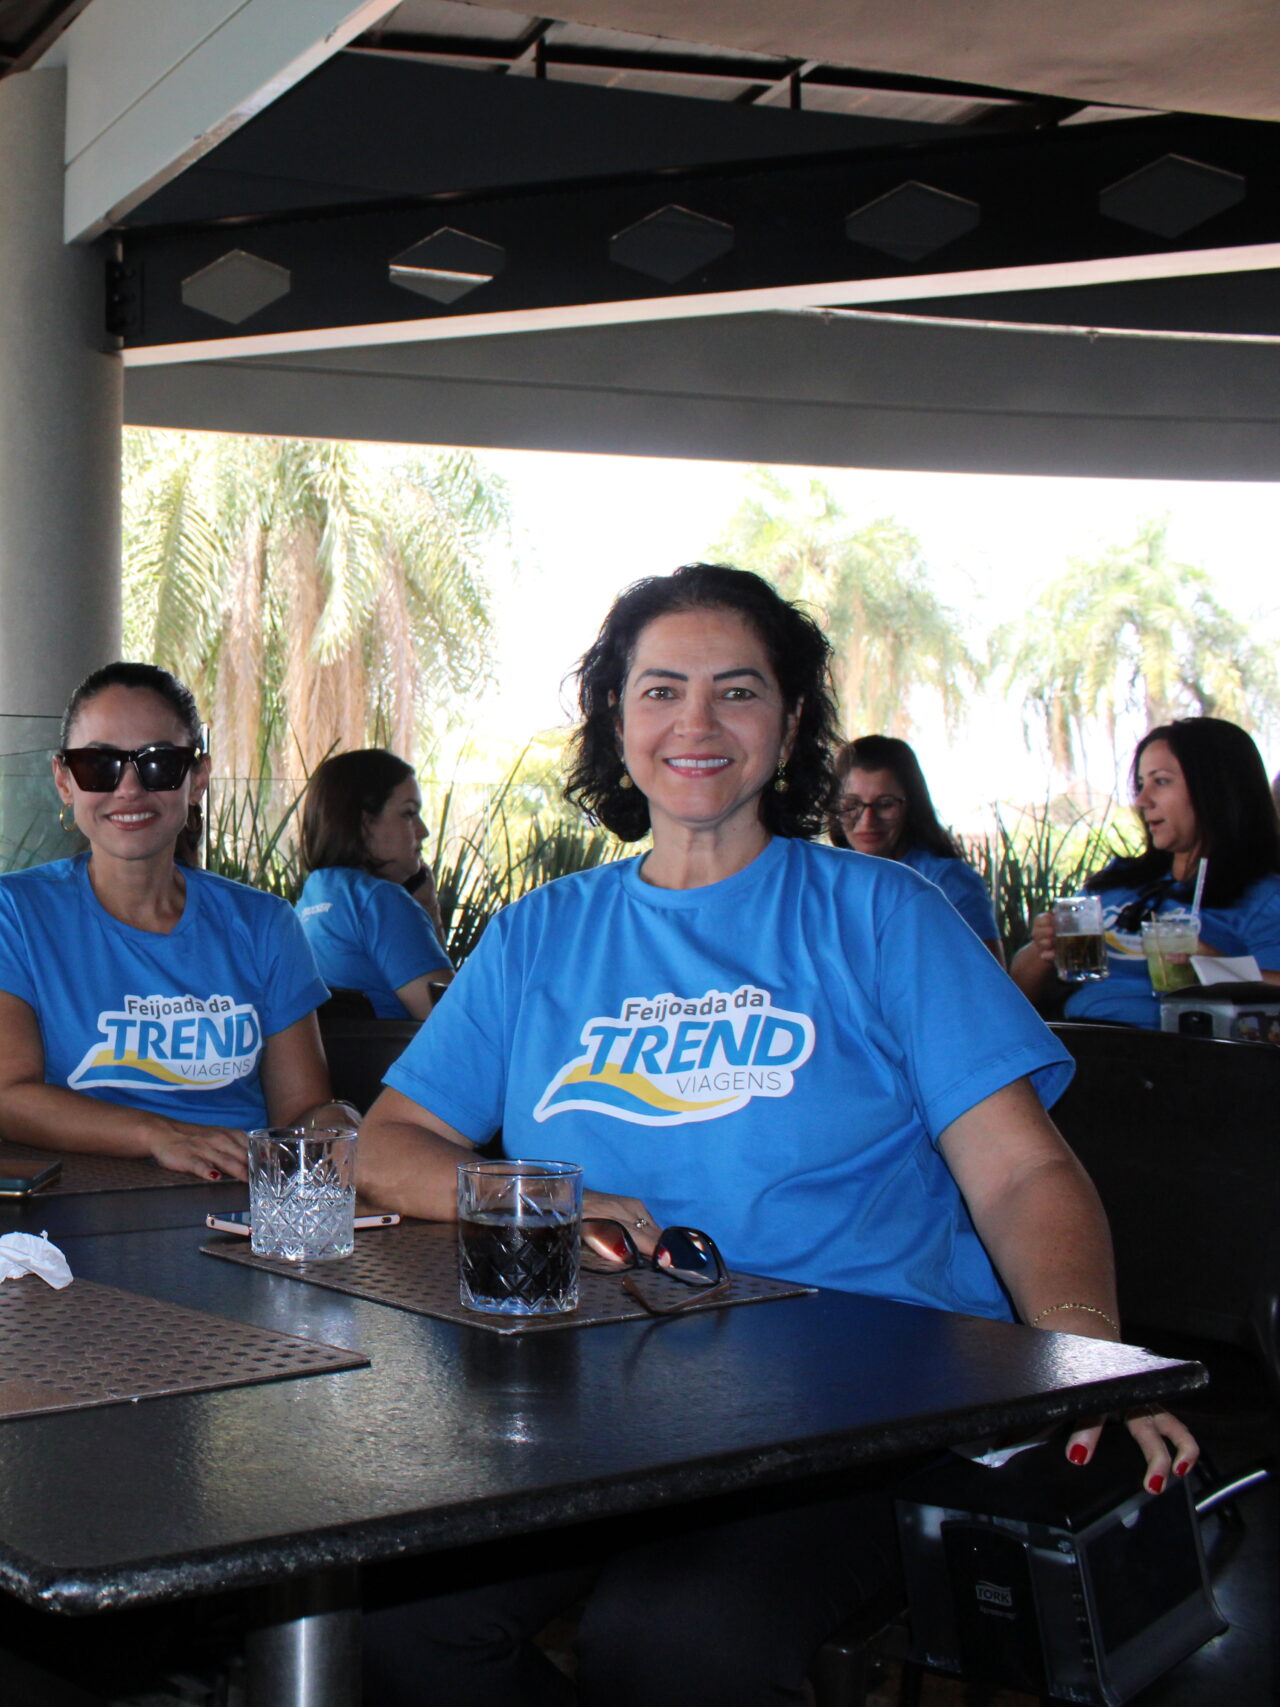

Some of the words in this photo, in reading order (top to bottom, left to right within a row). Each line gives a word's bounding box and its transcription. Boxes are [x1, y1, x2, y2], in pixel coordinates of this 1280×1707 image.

[127, 998, 204, 1019] Feijoada
[209, 998, 231, 1013] da
[624, 996, 727, 1022] Feijoada
[734, 990, 765, 1008] da
[106, 1013, 259, 1061] TREND
[588, 1014, 806, 1076] TREND
[180, 1061, 251, 1078] VIAGENS
[676, 1071, 782, 1095] VIAGENS
[978, 1588, 1009, 1603] TORK
